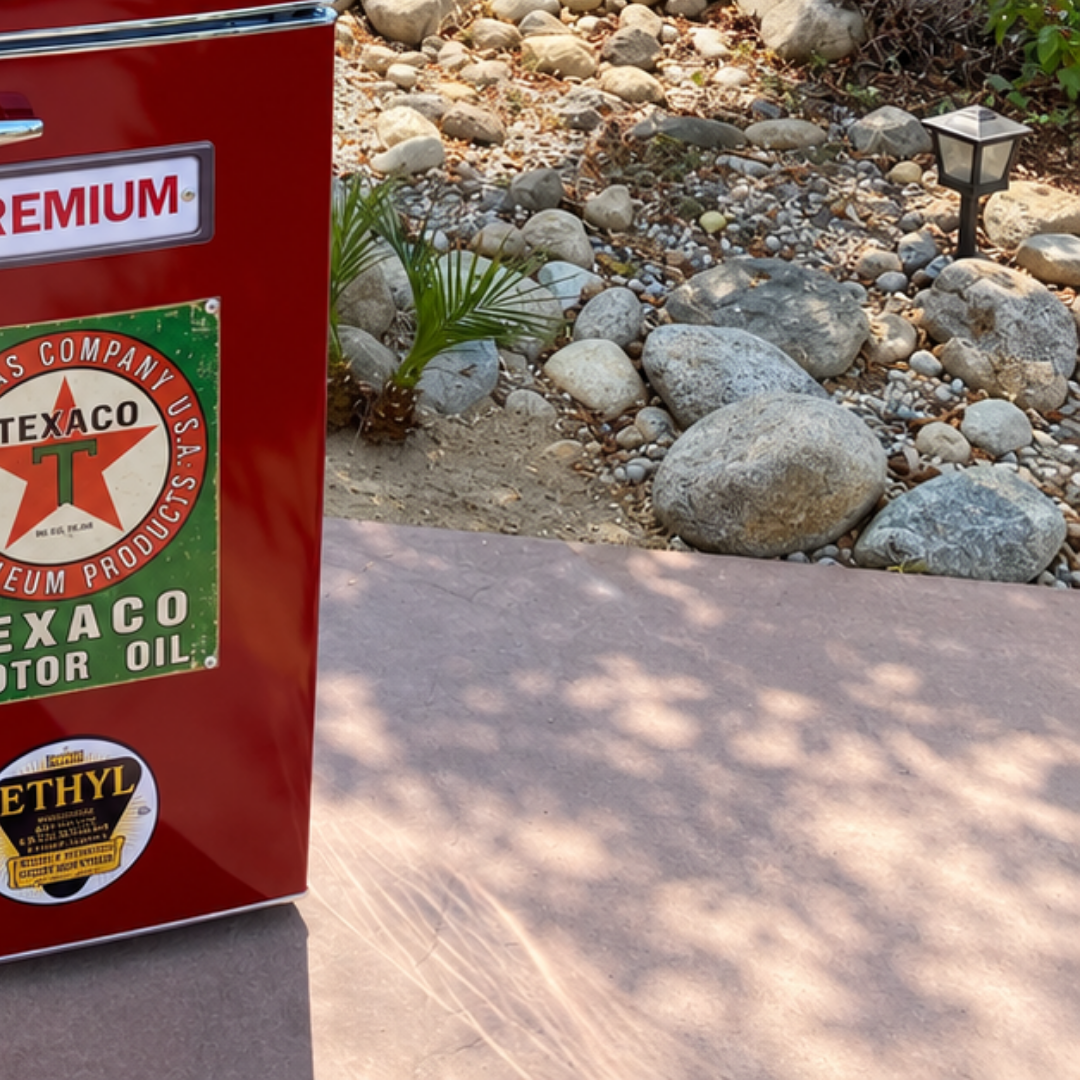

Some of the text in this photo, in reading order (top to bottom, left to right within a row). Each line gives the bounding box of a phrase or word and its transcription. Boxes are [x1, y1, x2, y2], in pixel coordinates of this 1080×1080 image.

[39, 336, 174, 391] COMPANY
[83, 474, 197, 589] PRODUCTS
[125, 634, 191, 672] OIL
